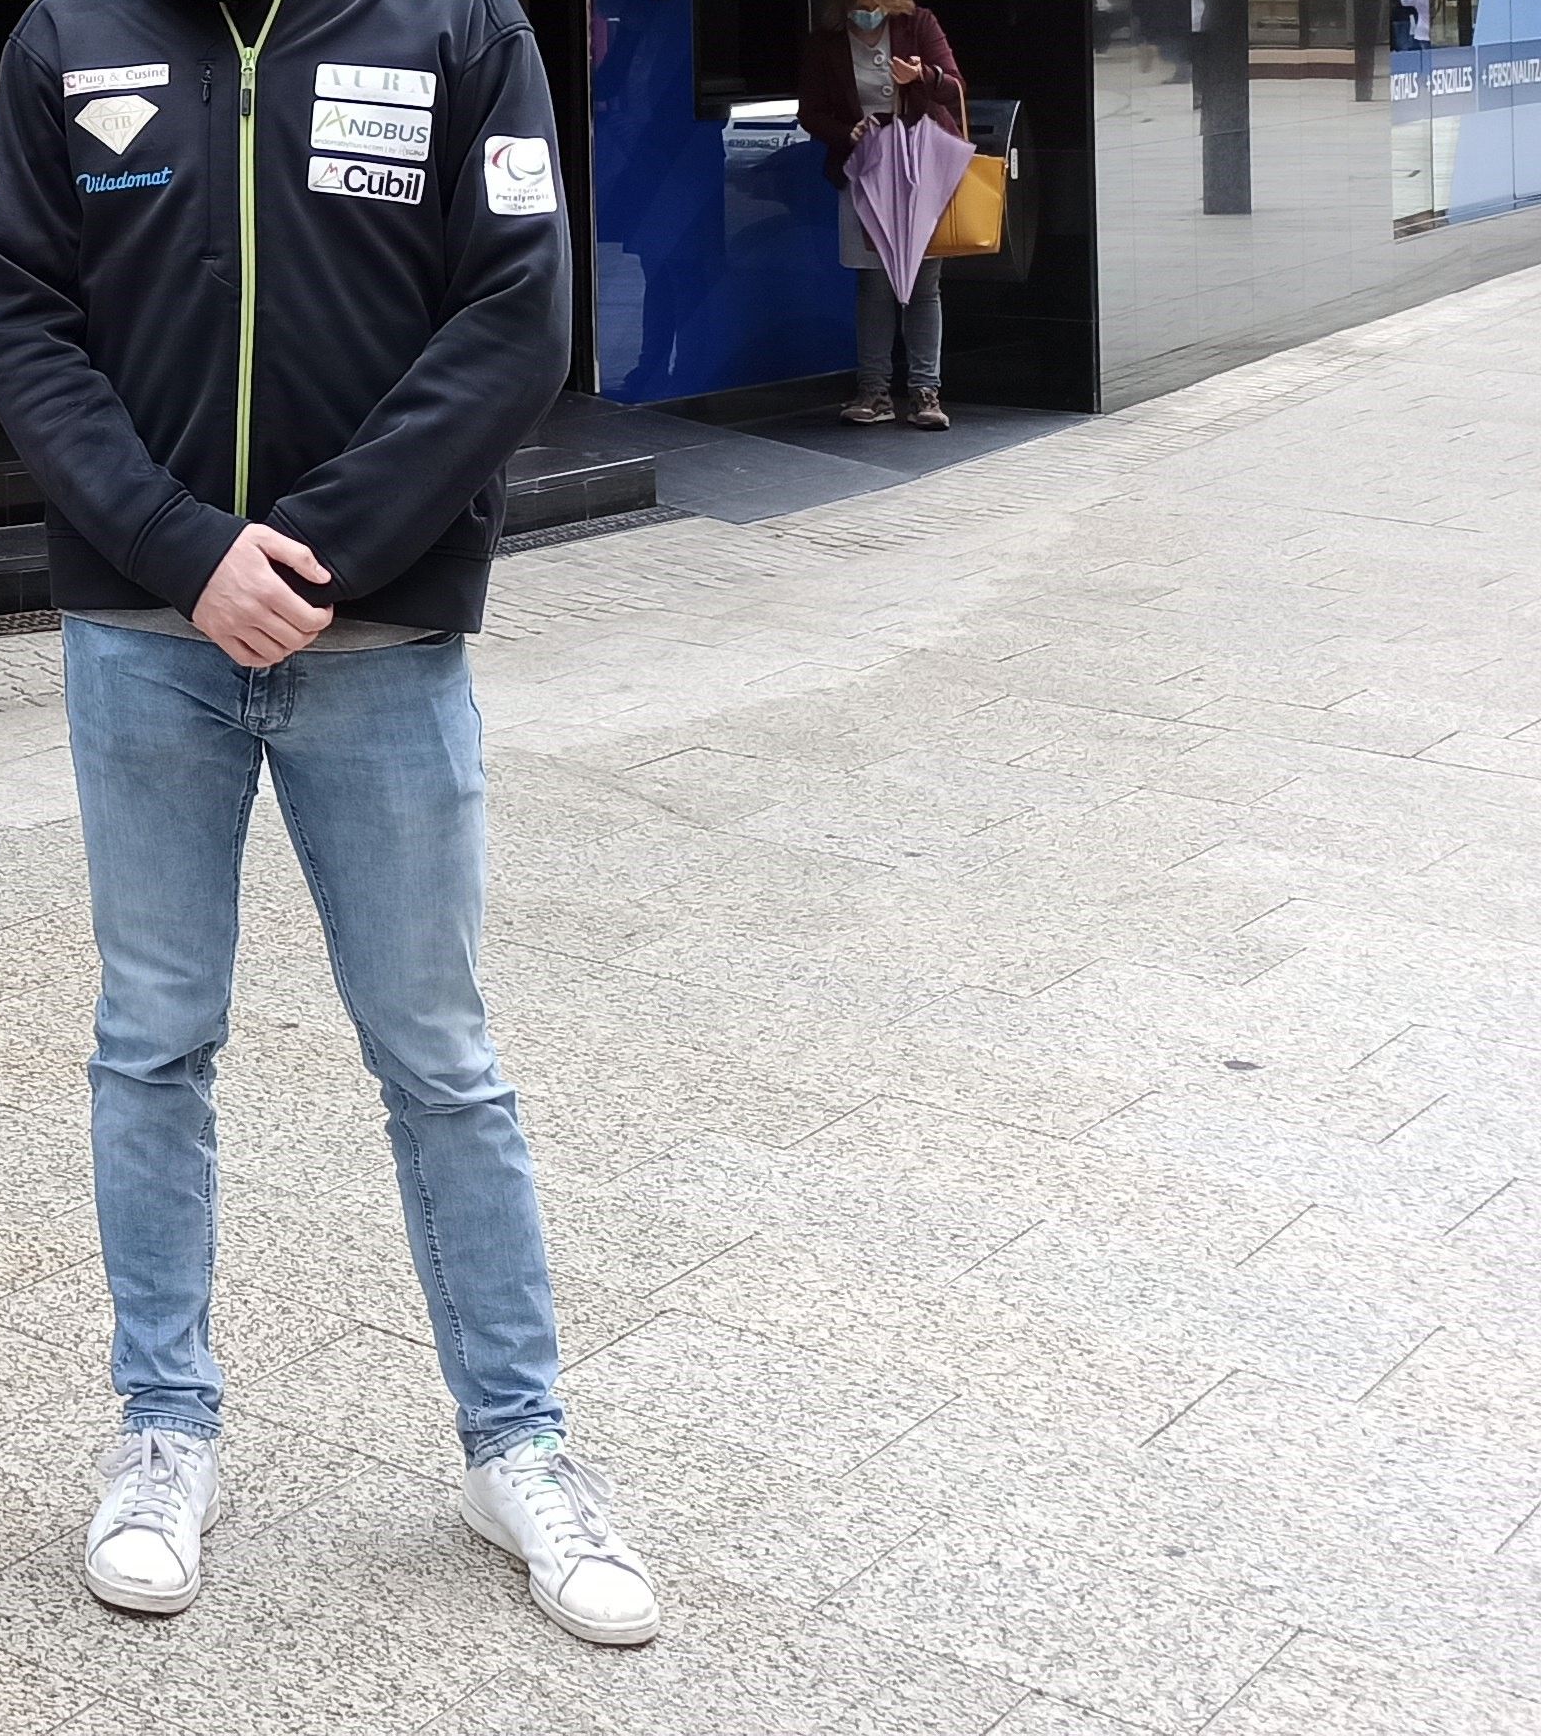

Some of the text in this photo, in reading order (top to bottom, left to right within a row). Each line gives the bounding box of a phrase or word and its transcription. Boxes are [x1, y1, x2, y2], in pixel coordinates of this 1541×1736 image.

[78, 73, 105, 85] Puig
[1431, 66, 1473, 96] SENZILLES
[1489, 57, 1541, 89] PERSONALITZ
[315, 104, 430, 144] ANDBUS
[76, 166, 173, 194] Viladomat
